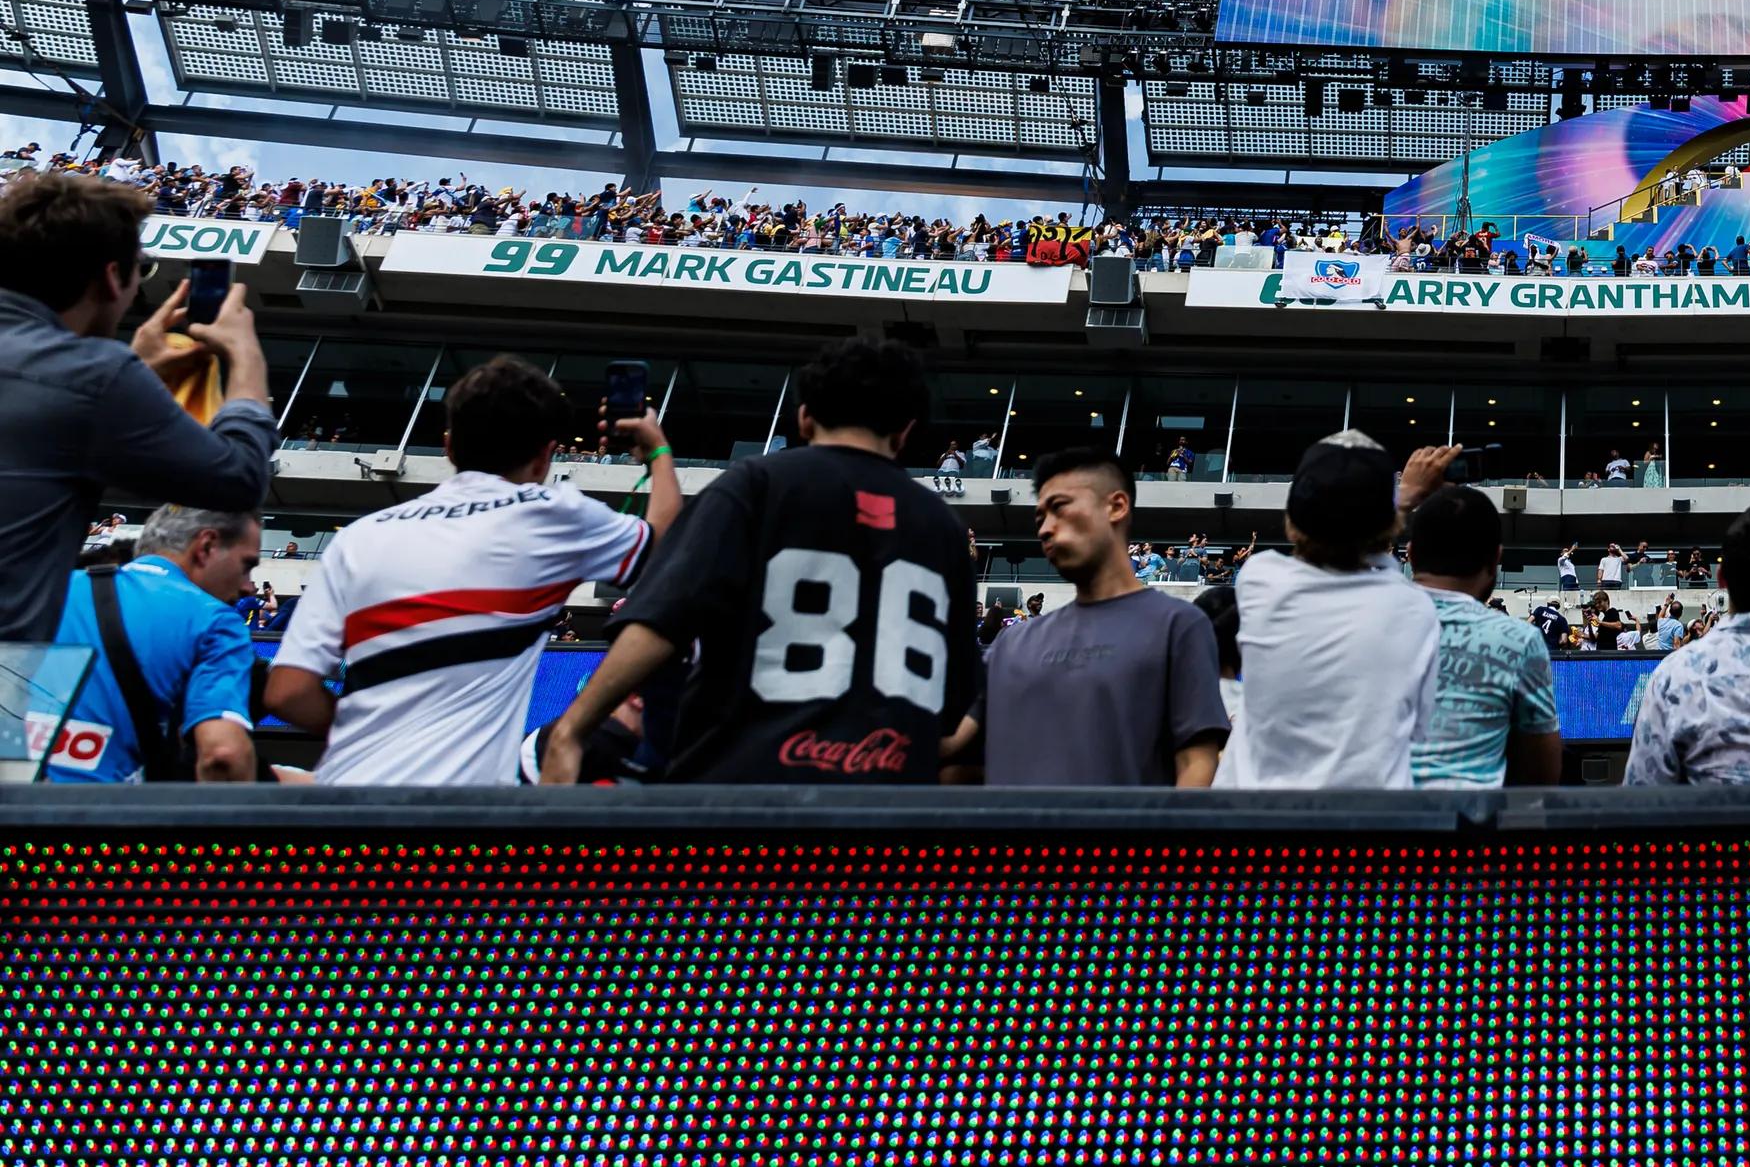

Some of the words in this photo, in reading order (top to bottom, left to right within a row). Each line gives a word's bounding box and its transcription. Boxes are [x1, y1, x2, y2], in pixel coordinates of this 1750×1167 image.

[138, 223, 261, 255] USON
[483, 240, 579, 276] 99
[594, 249, 738, 283] MARK
[744, 259, 992, 295] GASTINEAU
[1361, 279, 1501, 307] ARRY
[1510, 283, 1750, 310] GRANTHAM
[751, 547, 950, 715] 86
